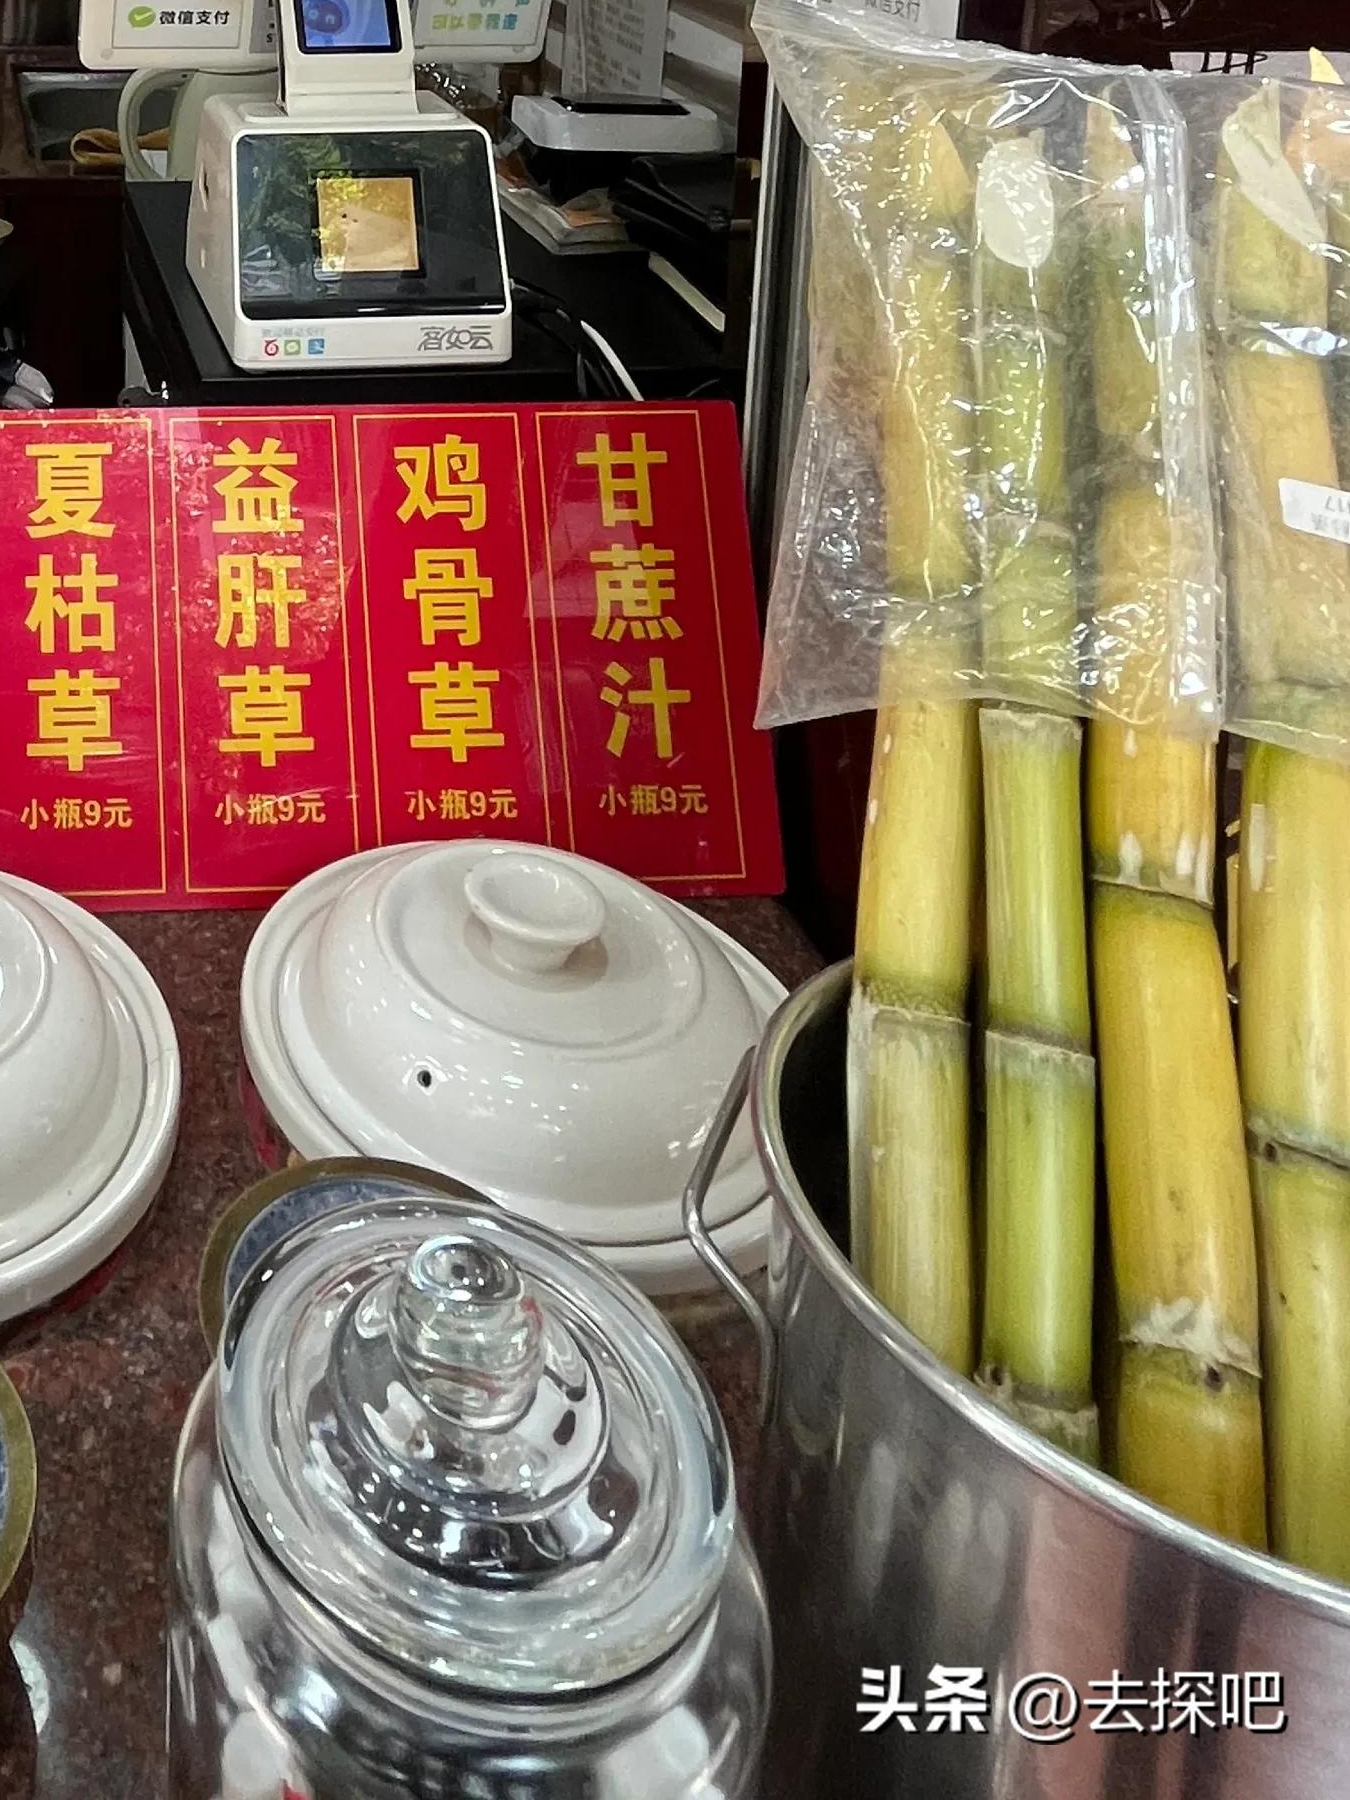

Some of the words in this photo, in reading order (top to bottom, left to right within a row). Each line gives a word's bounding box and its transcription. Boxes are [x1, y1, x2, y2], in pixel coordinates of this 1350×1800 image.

[159, 10, 230, 26] 微信支付
[25, 442, 124, 772] 夏枯草
[212, 437, 317, 768] 益肝草
[395, 433, 507, 764] 鸡骨草
[576, 432, 692, 760] 甘蔗汁
[20, 796, 133, 830] 小瓶9元
[214, 796, 326, 827] 小瓶9元
[407, 788, 518, 820] 小瓶9元
[599, 784, 708, 817] 小瓶9元
